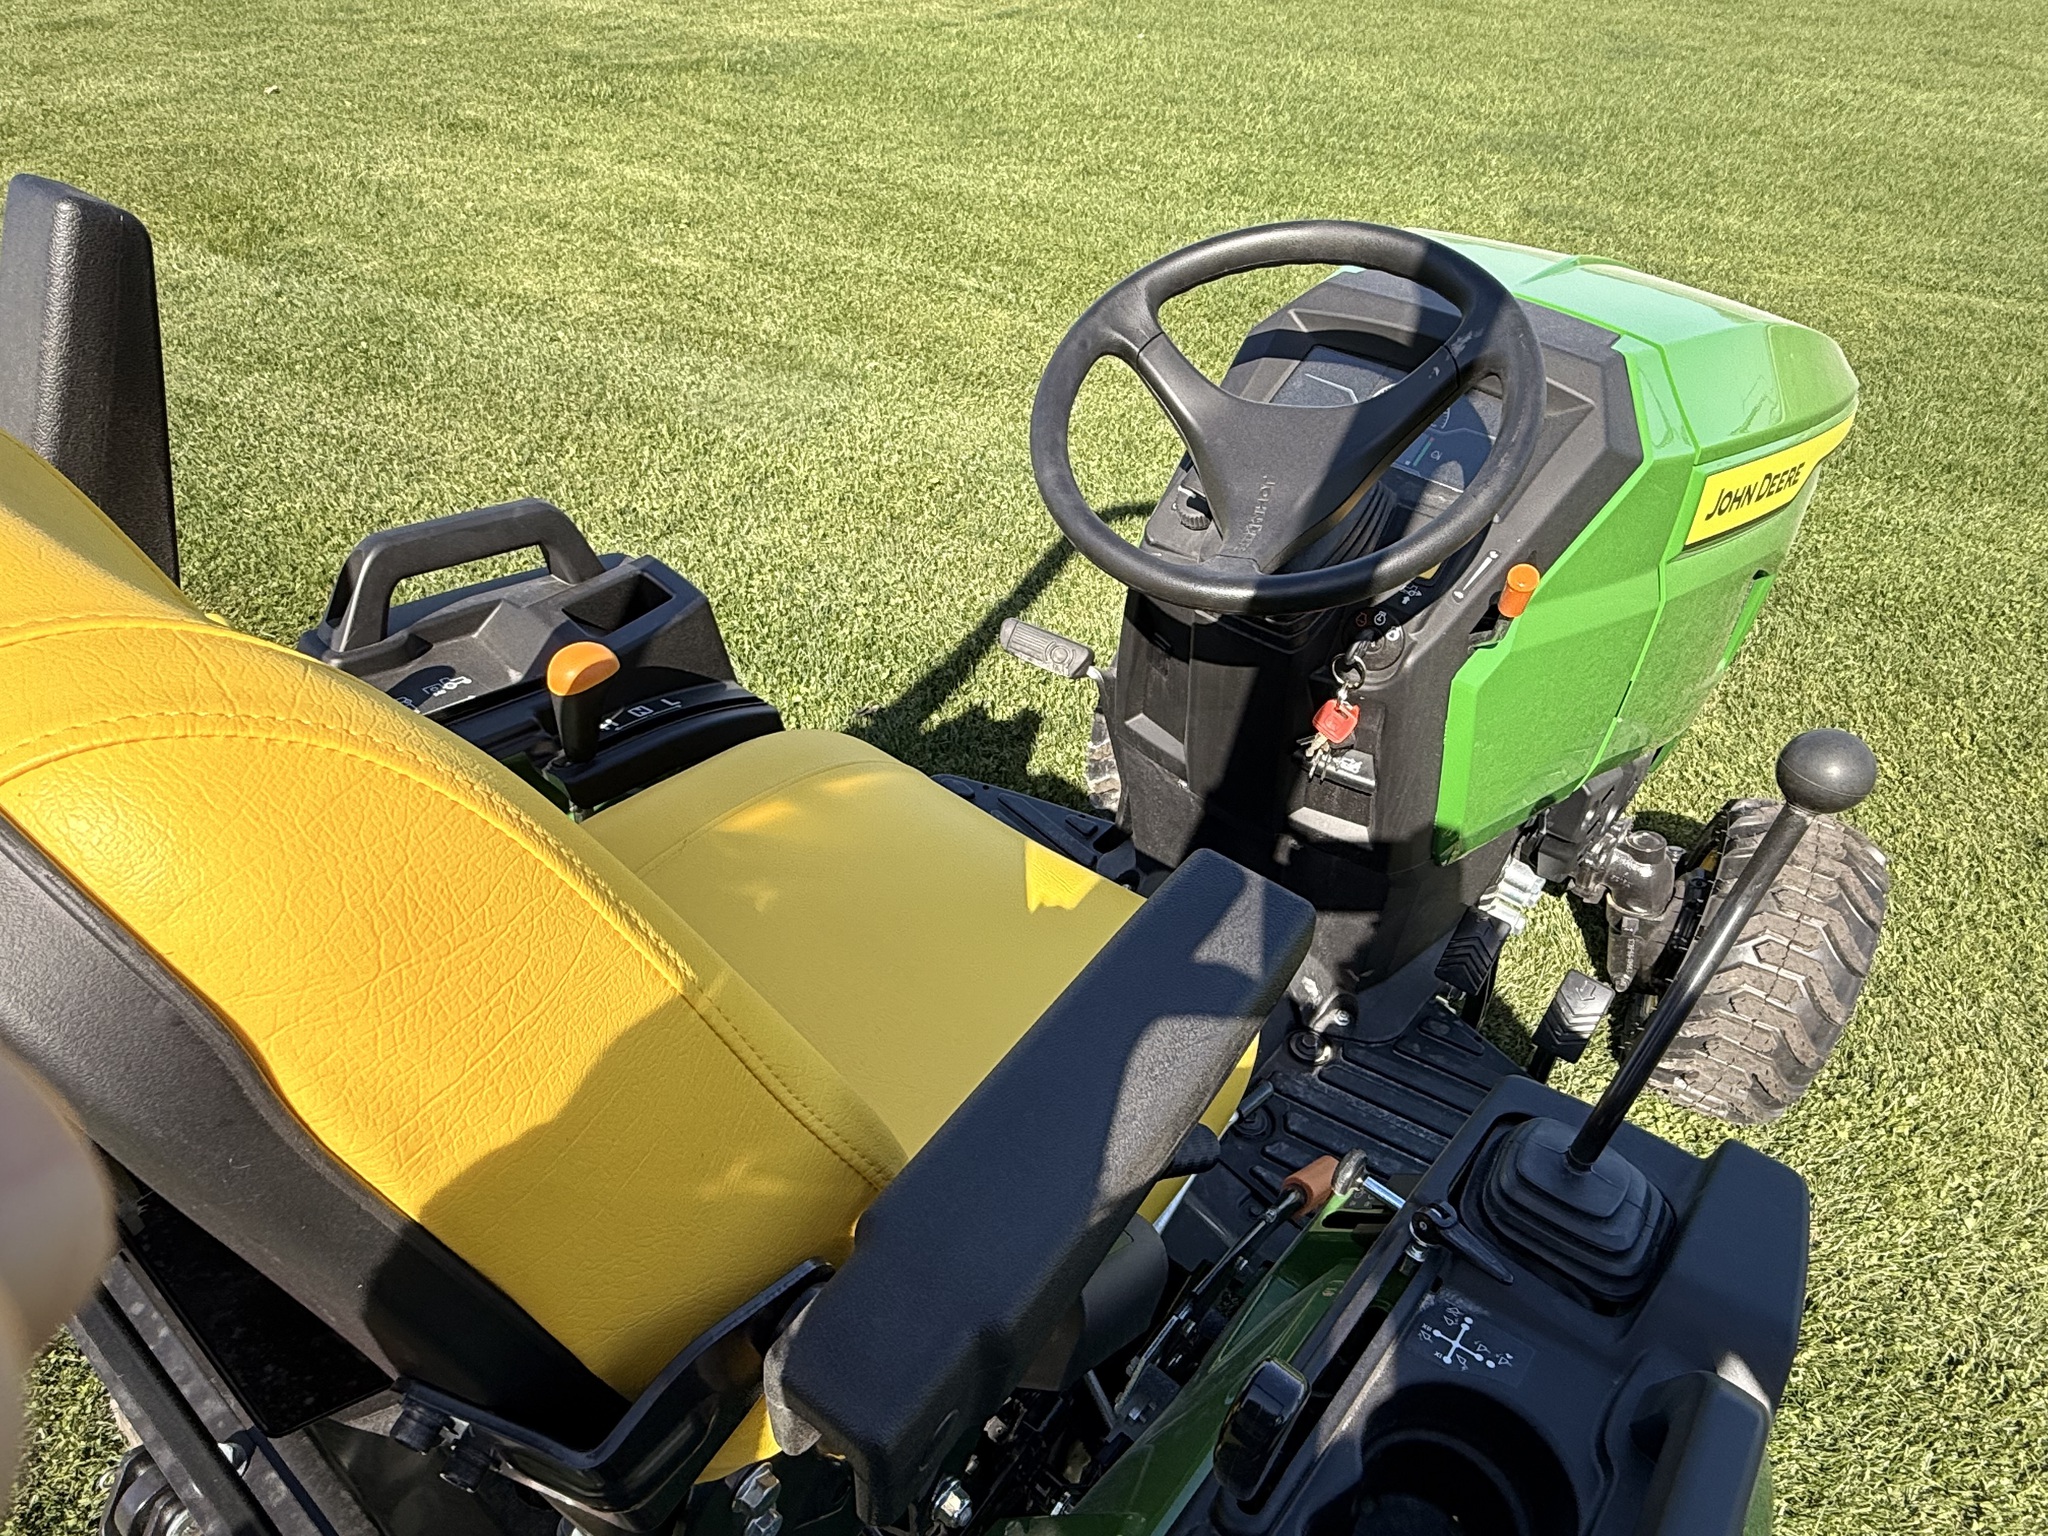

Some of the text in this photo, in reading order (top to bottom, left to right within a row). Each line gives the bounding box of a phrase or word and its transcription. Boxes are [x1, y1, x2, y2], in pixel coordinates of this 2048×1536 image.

[1705, 461, 1805, 521] JOHN DEERE
[660, 698, 681, 706] L
